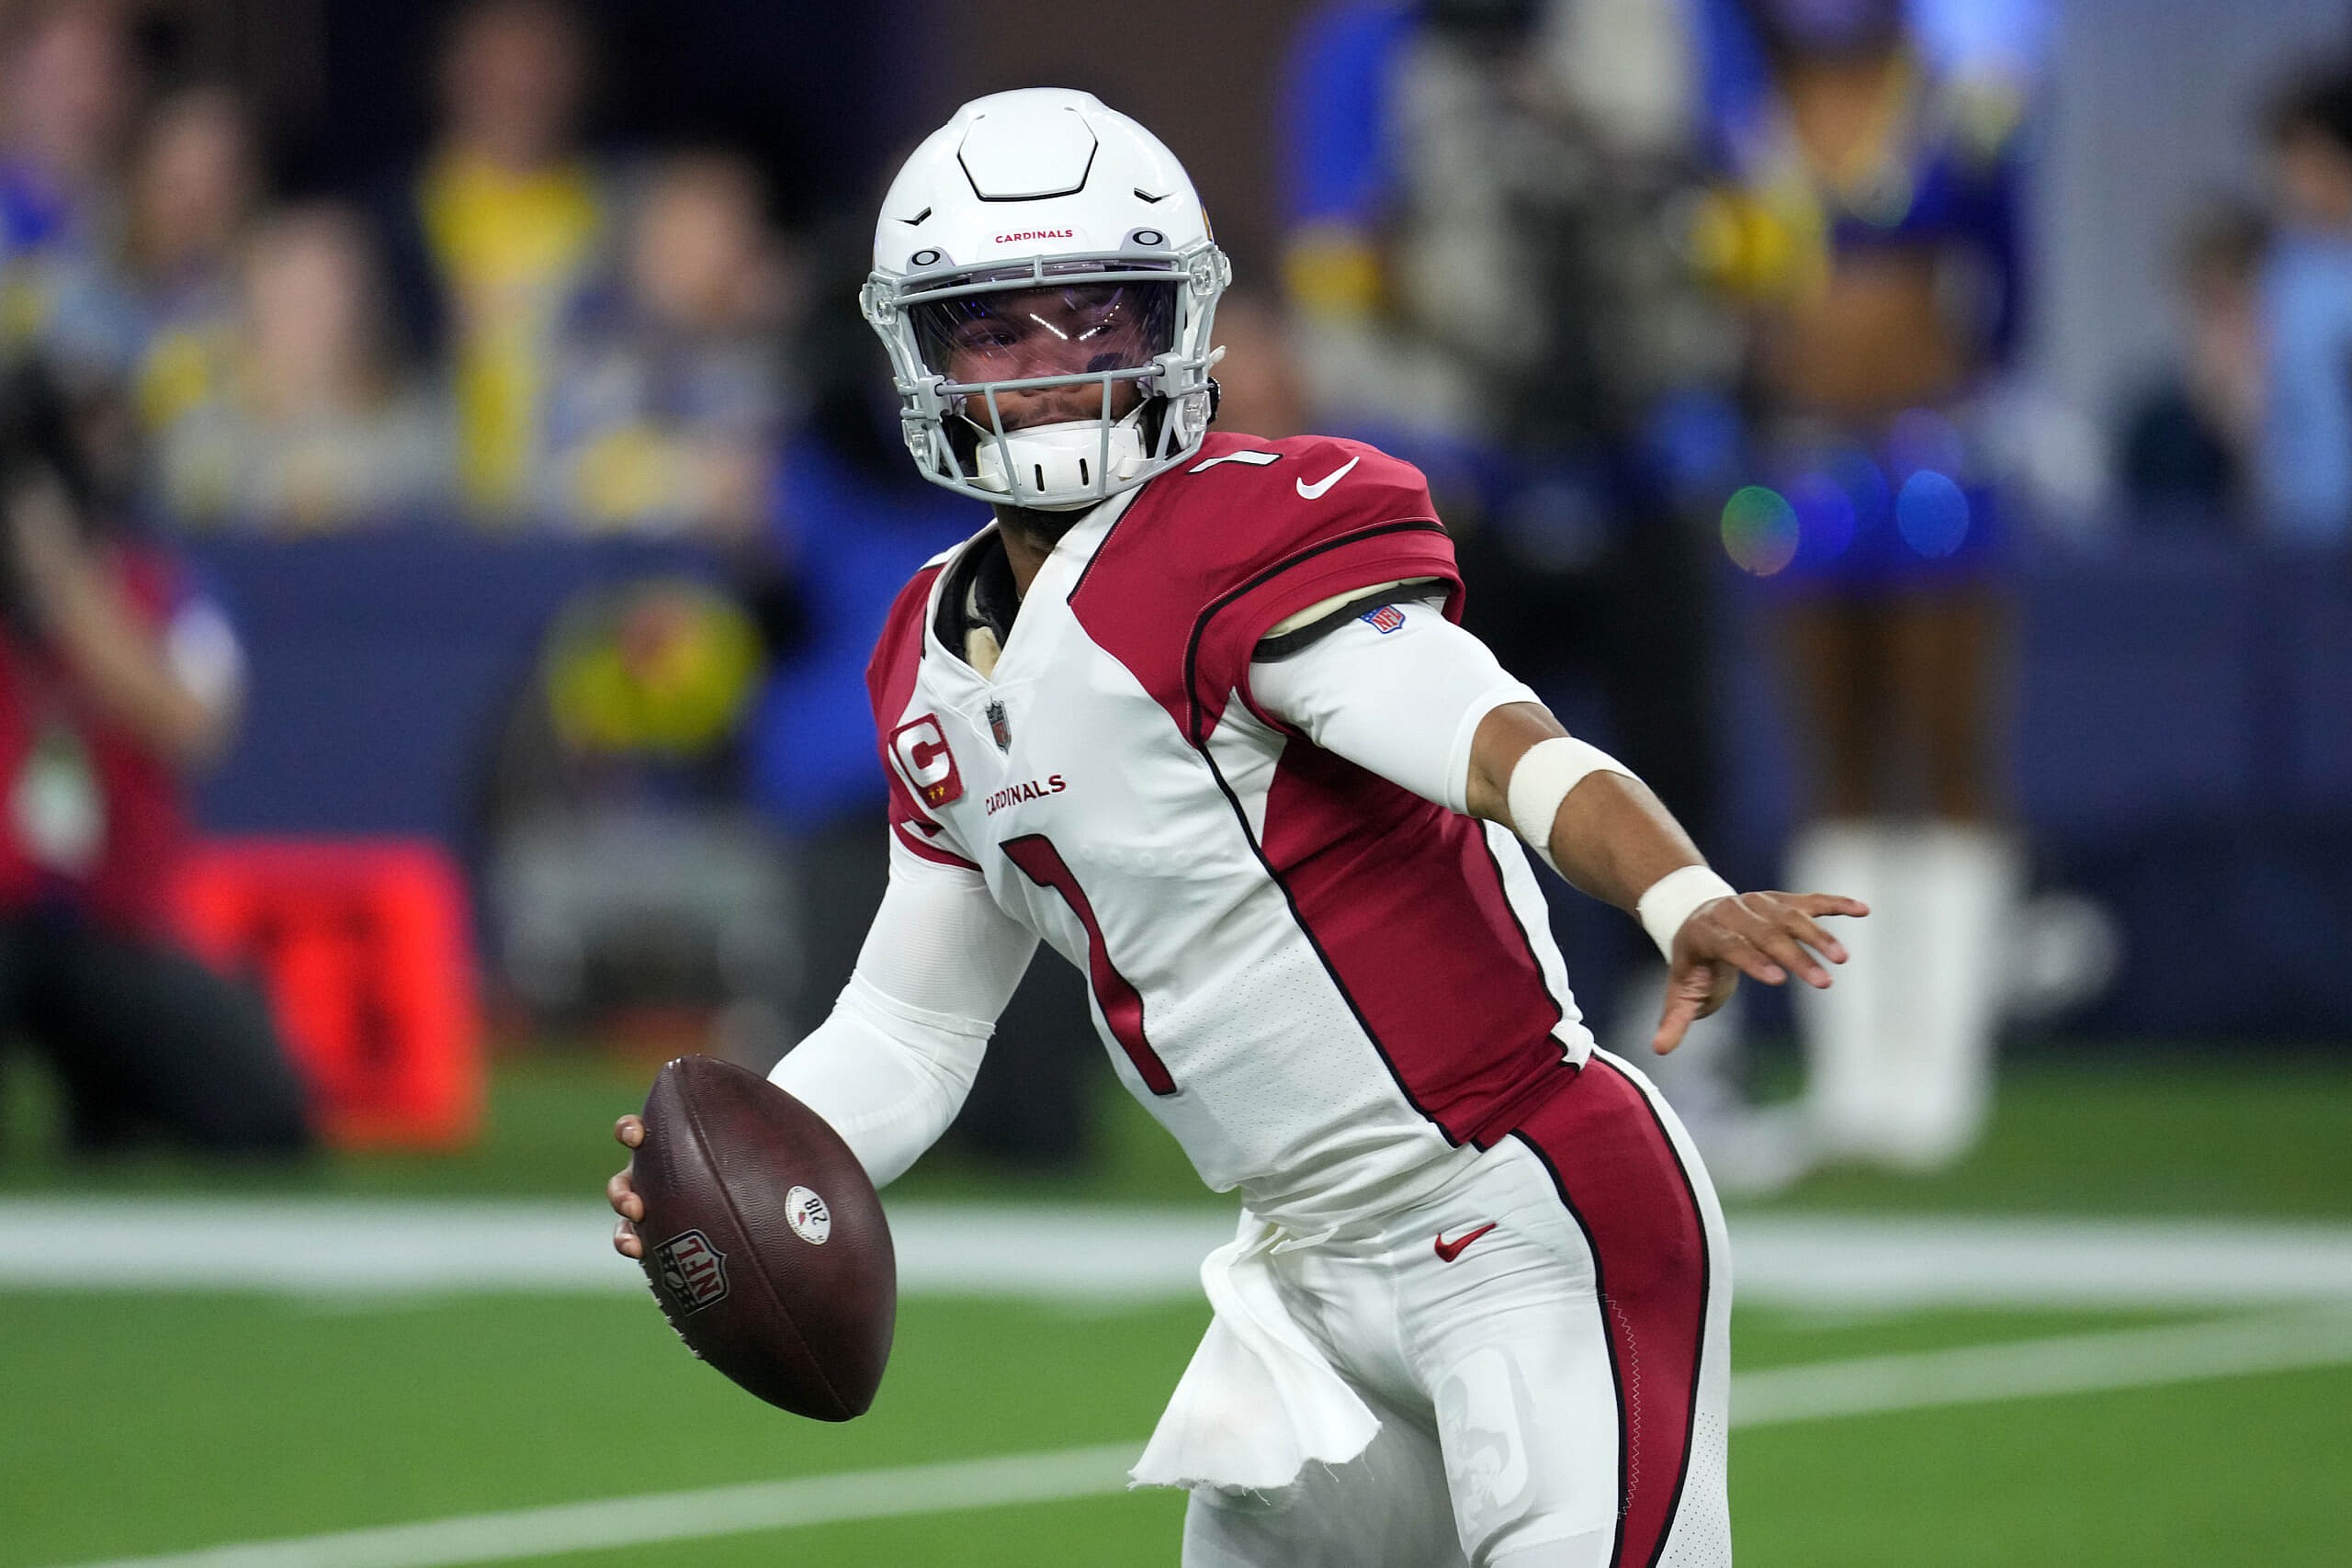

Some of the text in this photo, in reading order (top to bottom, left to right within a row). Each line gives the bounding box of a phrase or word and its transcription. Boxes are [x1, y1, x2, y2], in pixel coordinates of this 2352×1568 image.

[995, 230, 1073, 243] CARDINALS
[1372, 607, 1402, 631] NFL
[897, 721, 950, 788] C
[986, 774, 1067, 816] CARDINALS
[999, 833, 1177, 1096] 1
[677, 1237, 722, 1298] NFL
